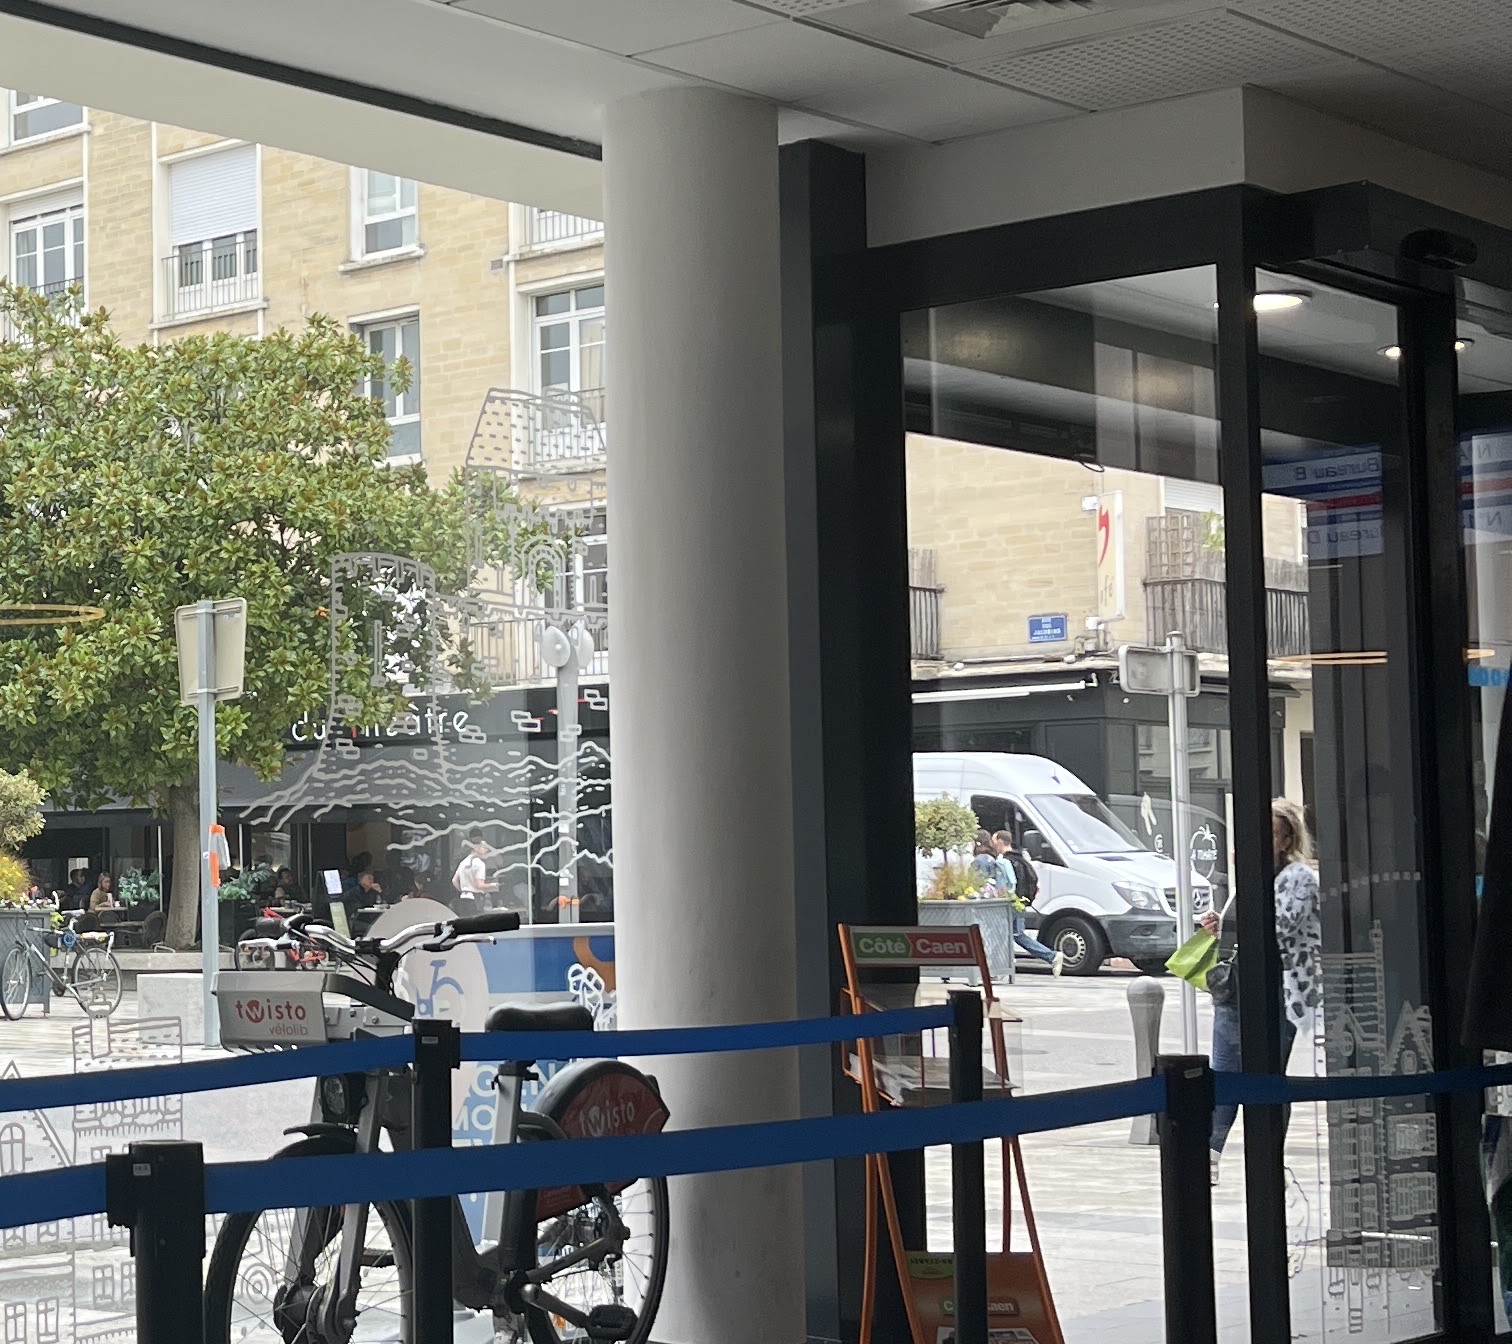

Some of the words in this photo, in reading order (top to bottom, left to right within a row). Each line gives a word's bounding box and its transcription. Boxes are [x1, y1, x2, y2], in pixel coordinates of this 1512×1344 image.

[859, 937, 906, 954] Côté
[916, 938, 968, 954] Caen
[235, 998, 306, 1024] twisto
[269, 1023, 308, 1036] vélolib
[579, 1098, 636, 1139] twisto
[987, 1301, 1015, 1312] aen
